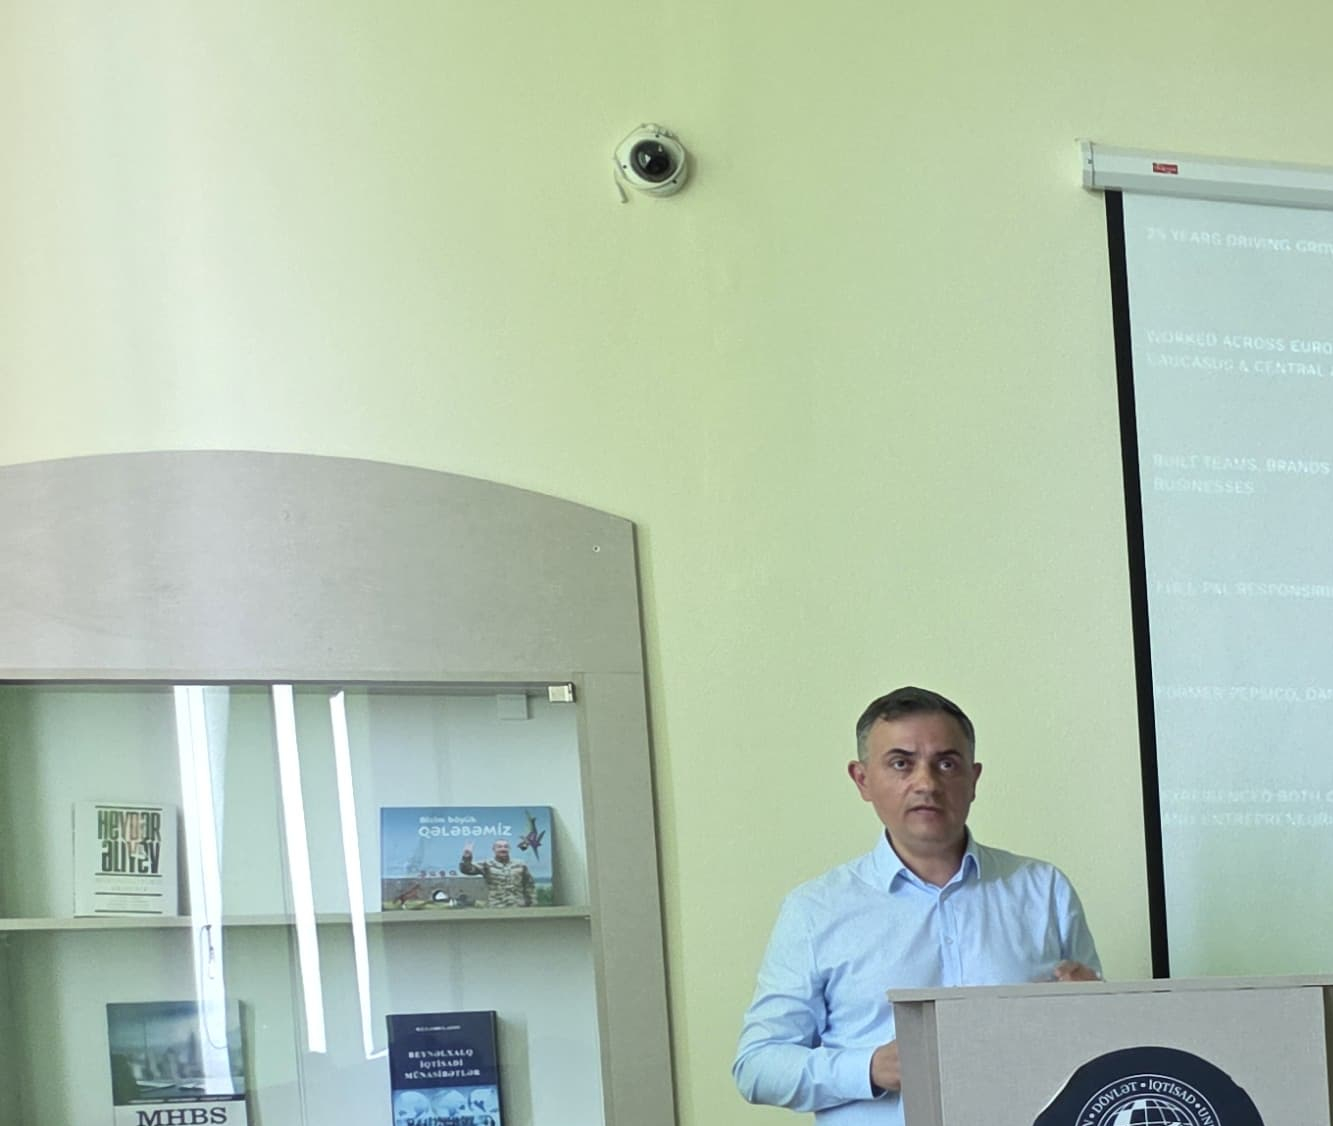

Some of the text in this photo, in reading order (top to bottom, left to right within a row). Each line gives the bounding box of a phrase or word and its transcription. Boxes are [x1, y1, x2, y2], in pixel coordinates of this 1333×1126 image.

[1170, 229, 1222, 246] YEARS
[1227, 234, 1291, 251] DRIVING
[1146, 330, 1217, 347] WORKED
[1222, 335, 1285, 352] ACROSS
[1254, 360, 1324, 378] CENTRAL
[1266, 459, 1330, 475] BRANDS
[1153, 478, 1255, 495] BUSINESSES
